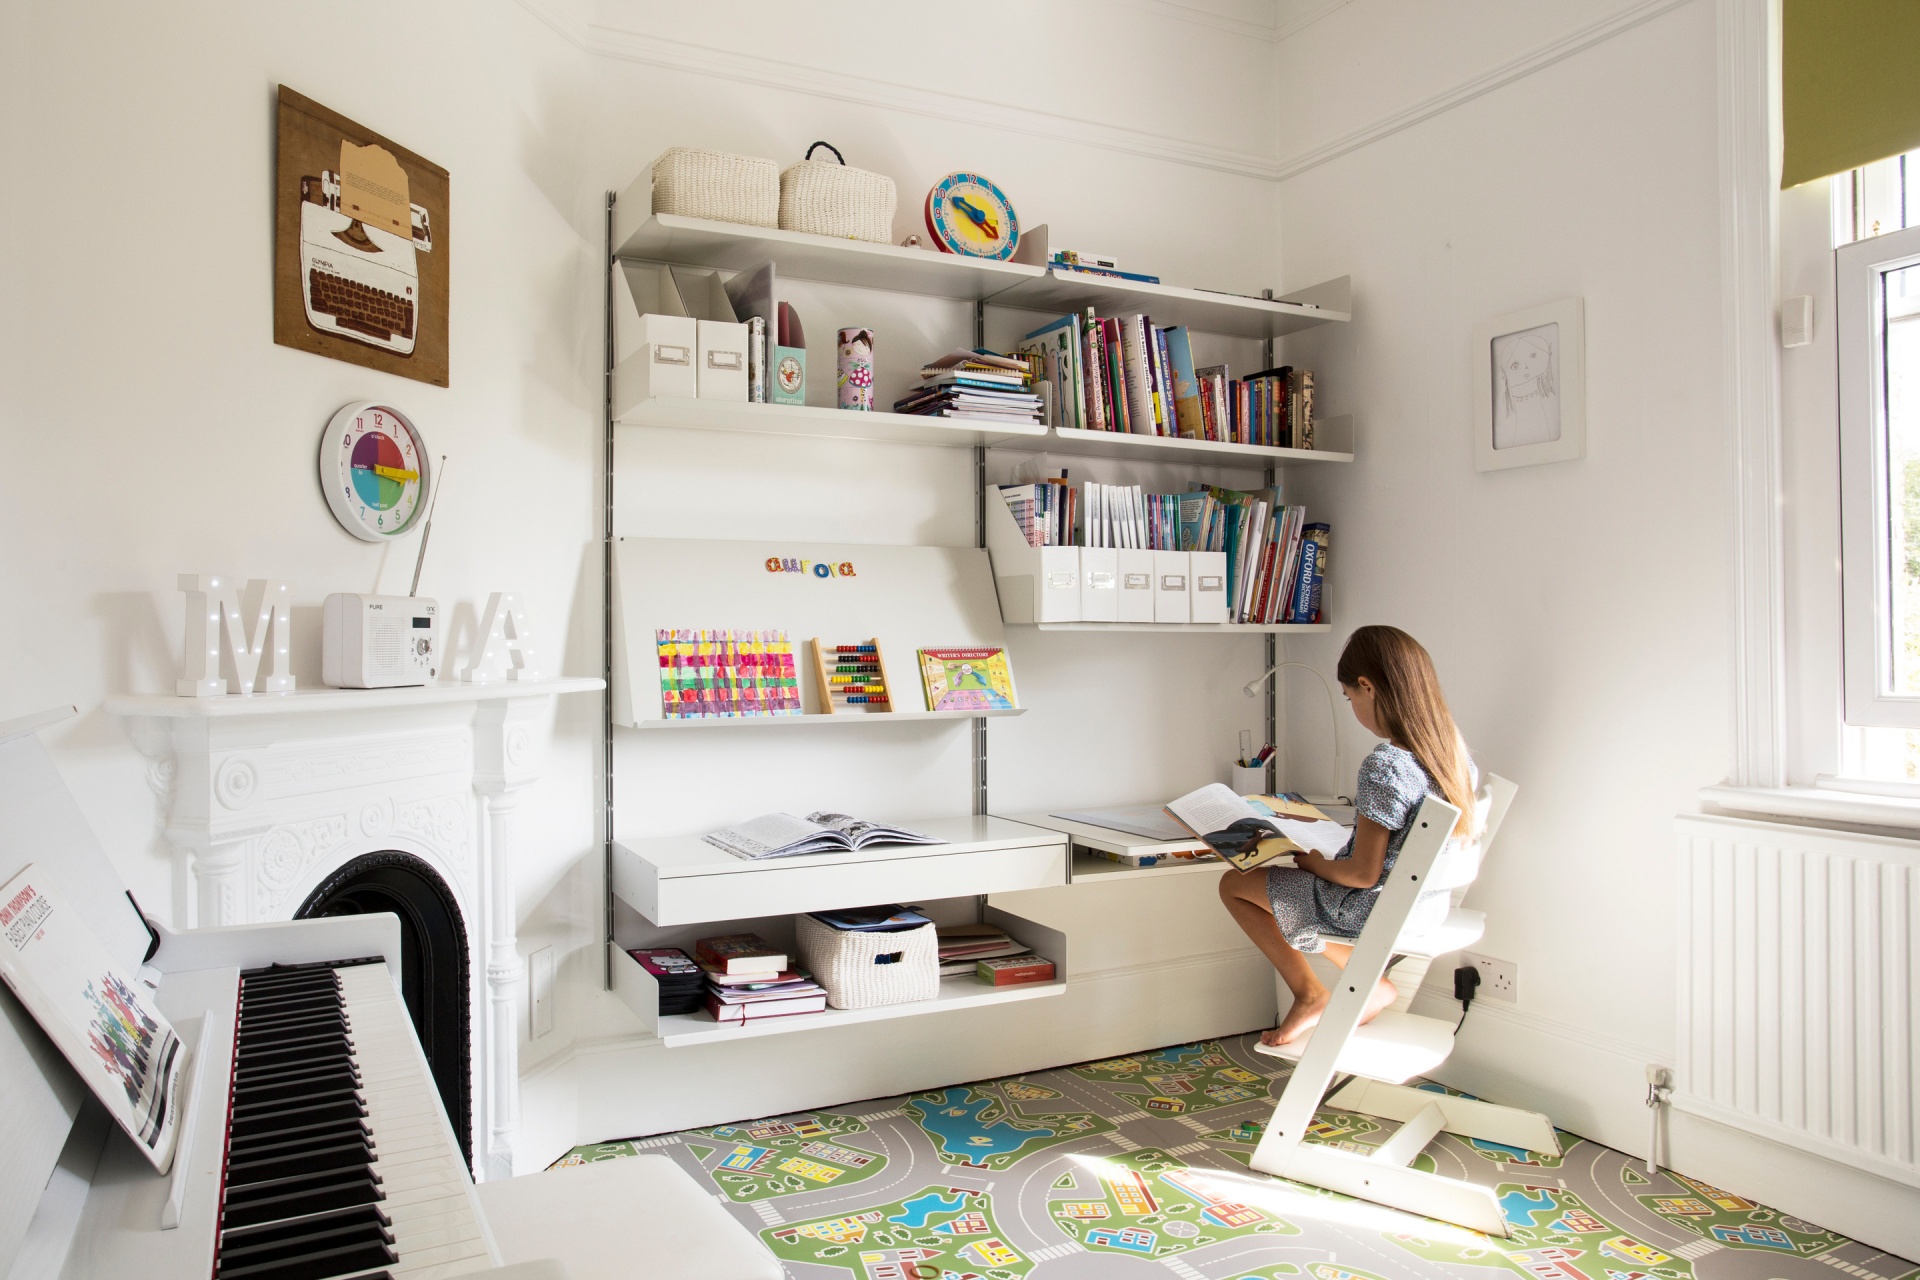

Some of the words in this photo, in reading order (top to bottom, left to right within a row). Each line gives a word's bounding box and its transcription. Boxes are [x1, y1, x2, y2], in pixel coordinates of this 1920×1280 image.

[948, 175, 958, 186] 11
[966, 174, 977, 184] 12
[988, 182, 993, 192] 1
[935, 188, 946, 199] 10
[1004, 200, 1010, 211] 2
[935, 208, 941, 218] 9
[1011, 221, 1017, 231] 3
[943, 230, 950, 240] 8
[1008, 240, 1013, 250] 4
[356, 418, 363, 429] 11
[374, 413, 383, 426] 12
[393, 425, 397, 435] 1
[406, 444, 412, 455] 2
[407, 494, 412, 506] 4
[360, 506, 365, 518] 7
[395, 510, 400, 520] 5
[378, 514, 383, 526] 6
[766, 555, 857, 578] aurora
[1302, 544, 1315, 584] OXFORD
[177, 574, 296, 697] M
[461, 592, 548, 682] A
[8, 884, 36, 916] THOMPSON'S
